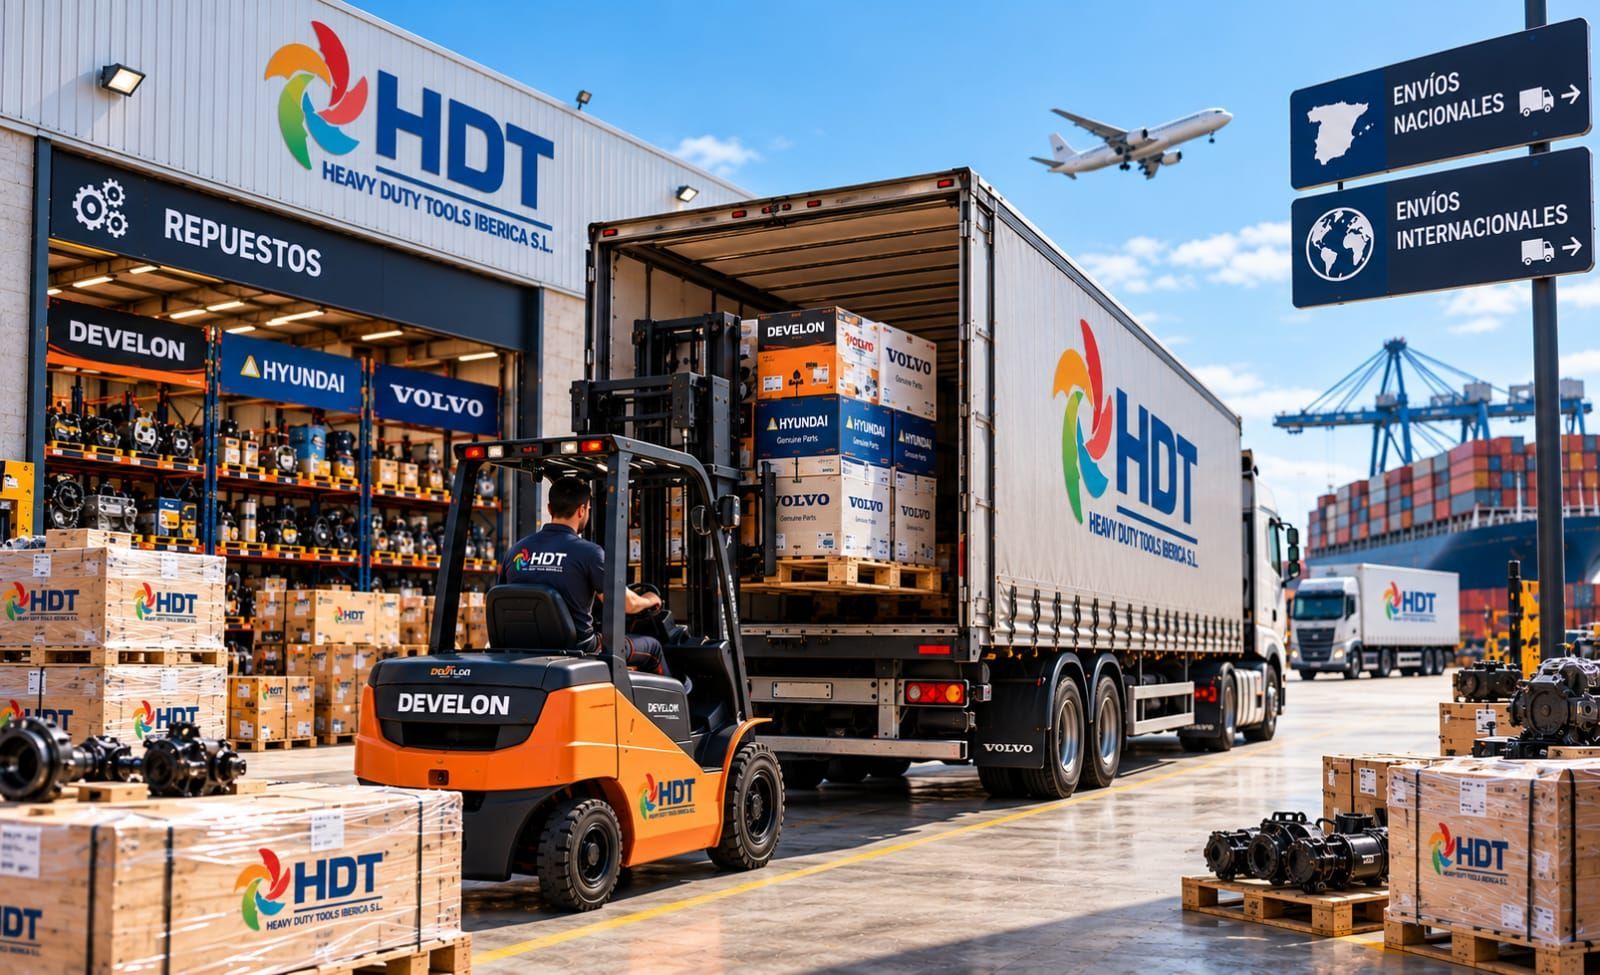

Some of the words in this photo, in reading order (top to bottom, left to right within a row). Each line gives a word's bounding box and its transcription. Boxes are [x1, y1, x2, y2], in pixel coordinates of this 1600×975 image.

[1393, 71, 1460, 105] ENVÍOS
[1394, 92, 1504, 135] NACIONALES
[376, 69, 554, 210] HDT
[322, 160, 377, 196] HEAVY
[379, 180, 424, 210] DUTY
[424, 193, 471, 228] TOOLS
[474, 212, 529, 248] IBERICA
[530, 232, 554, 254] S.L.
[1396, 190, 1460, 221] ENVÍOS
[1397, 203, 1568, 250] INTERNACIONALES
[164, 208, 321, 278] REPUESTOS
[69, 319, 186, 361] DEVELON
[767, 321, 825, 338] DEVELON
[886, 347, 931, 375] VOLVO
[263, 359, 345, 393] HYUNDAI
[389, 383, 484, 417] VOLVO
[779, 414, 828, 430] HYUNDAI
[854, 419, 886, 437] HYUNDAI
[776, 435, 801, 444] Genuine
[802, 434, 819, 443] Parts
[905, 432, 932, 450] HYUNDAI
[1116, 387, 1197, 525] HDT
[849, 496, 883, 512] VOLVO
[901, 505, 930, 520] VOLVO
[779, 514, 801, 522] Genuine
[1089, 511, 1118, 540] HEAVY
[1119, 522, 1138, 546] DUTY
[1139, 530, 1161, 555] TOOLS
[1162, 540, 1186, 565] IBERICA
[530, 551, 567, 566] HDT
[30, 590, 79, 611] HDT
[156, 591, 198, 614] HDT
[1402, 591, 1437, 613] HDT
[344, 610, 365, 620] HDT
[156, 706, 199, 729] HDT
[397, 693, 509, 716] DEVELON
[983, 743, 1033, 754] VOLVO
[658, 778, 695, 807] HDT
[1456, 836, 1509, 870] HDT
[294, 851, 383, 903] HDT
[0, 905, 42, 940] DT
[266, 918, 292, 931] HEAVY
[294, 914, 314, 926] DUTY
[316, 910, 340, 922] TOOLS
[341, 905, 369, 917] IBERICA
